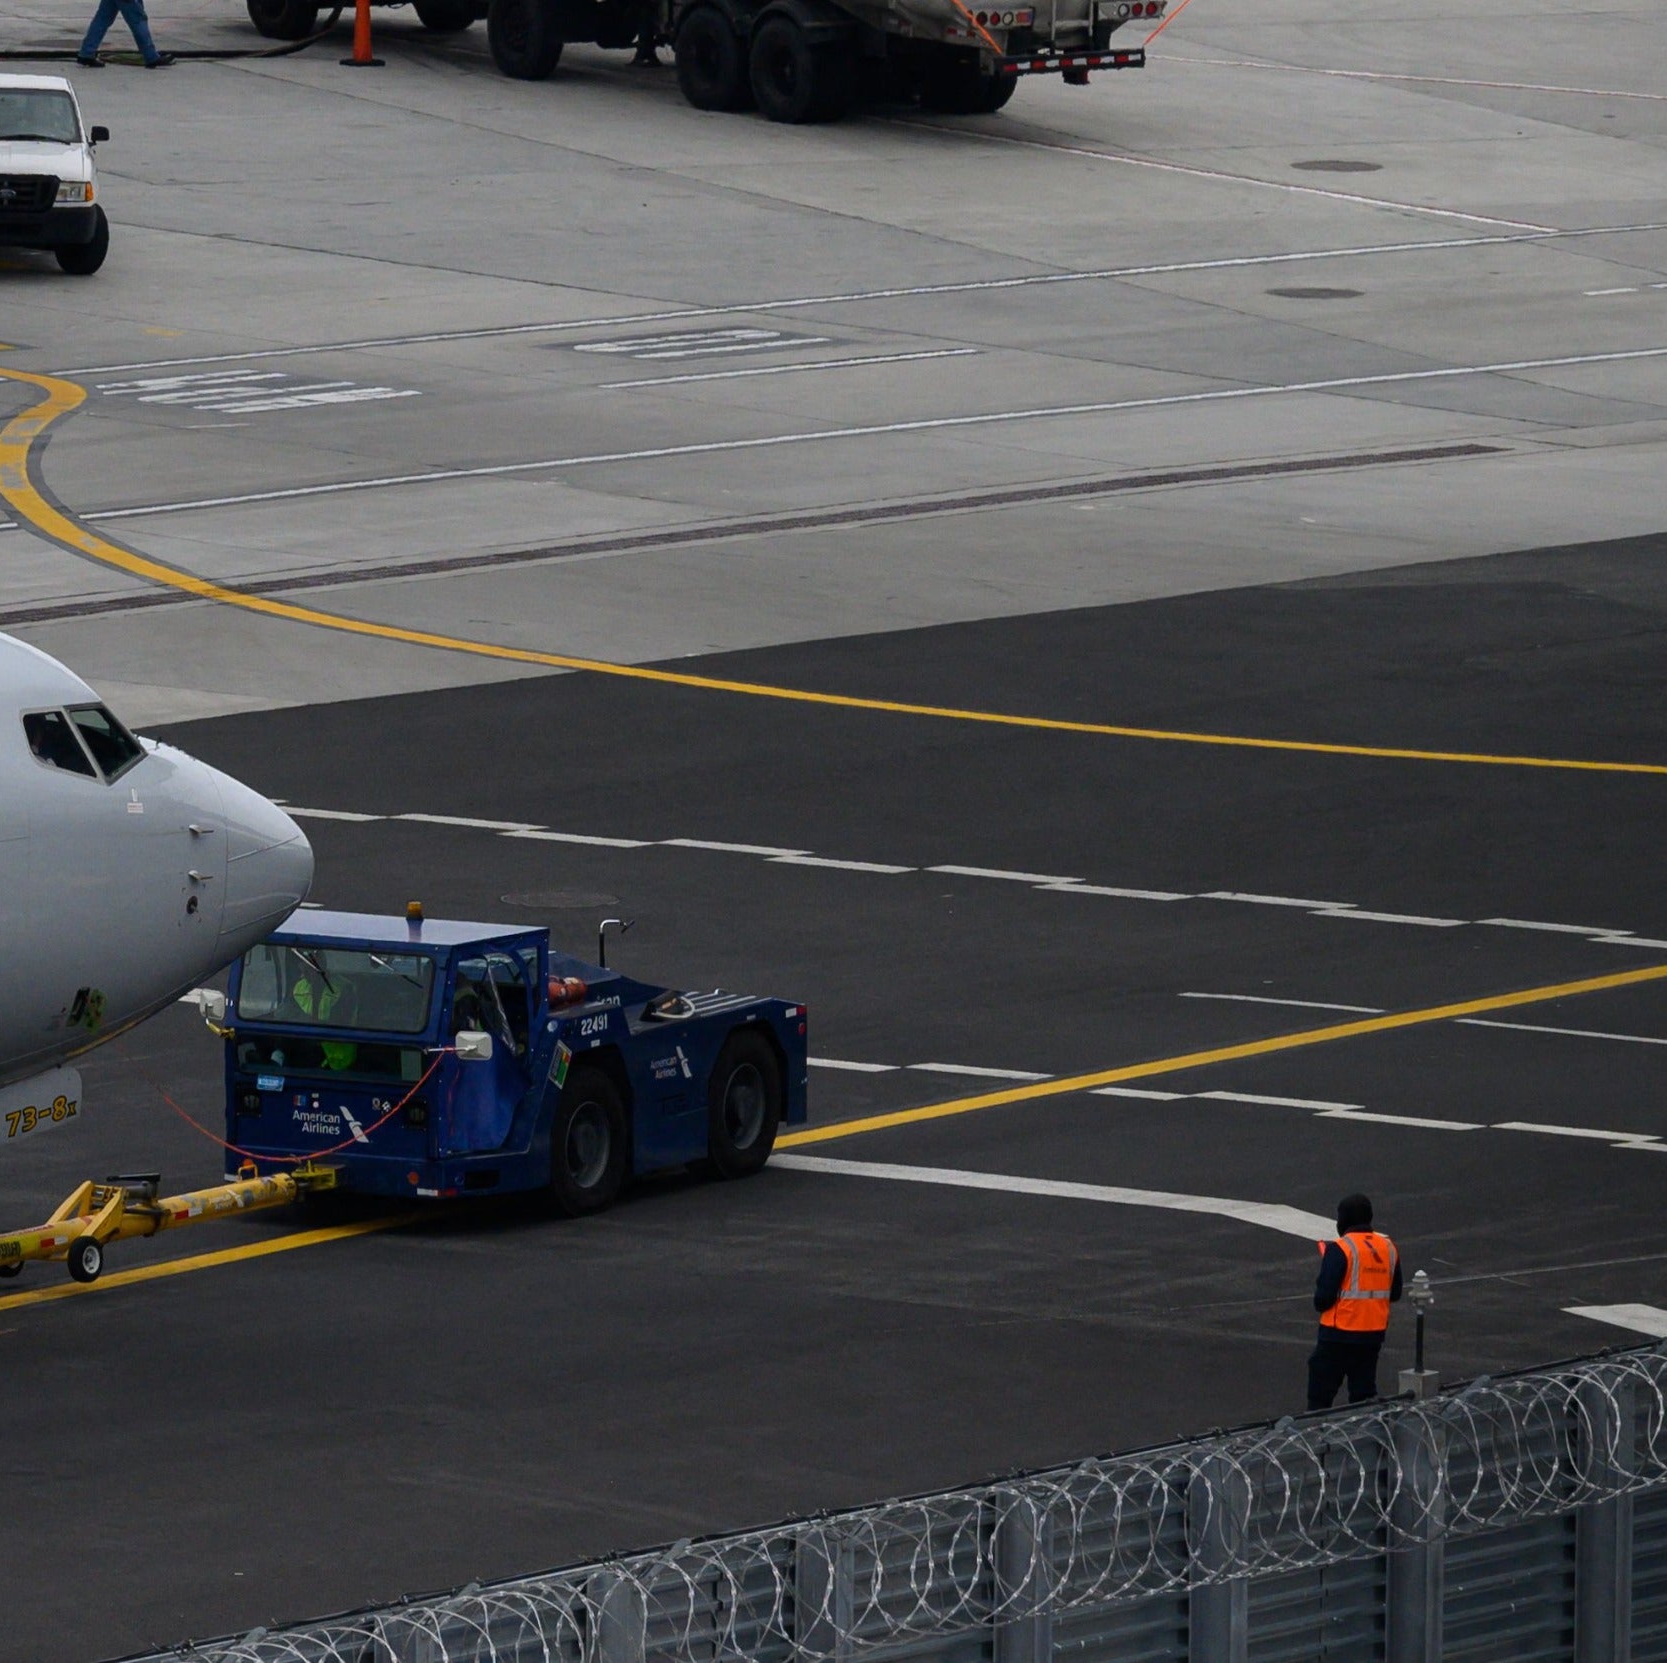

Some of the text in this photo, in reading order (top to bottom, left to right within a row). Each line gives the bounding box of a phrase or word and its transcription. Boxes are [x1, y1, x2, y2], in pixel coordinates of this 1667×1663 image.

[580, 1013, 609, 1036] 22491
[292, 1109, 341, 1124] American
[301, 1122, 341, 1136] Airlines
